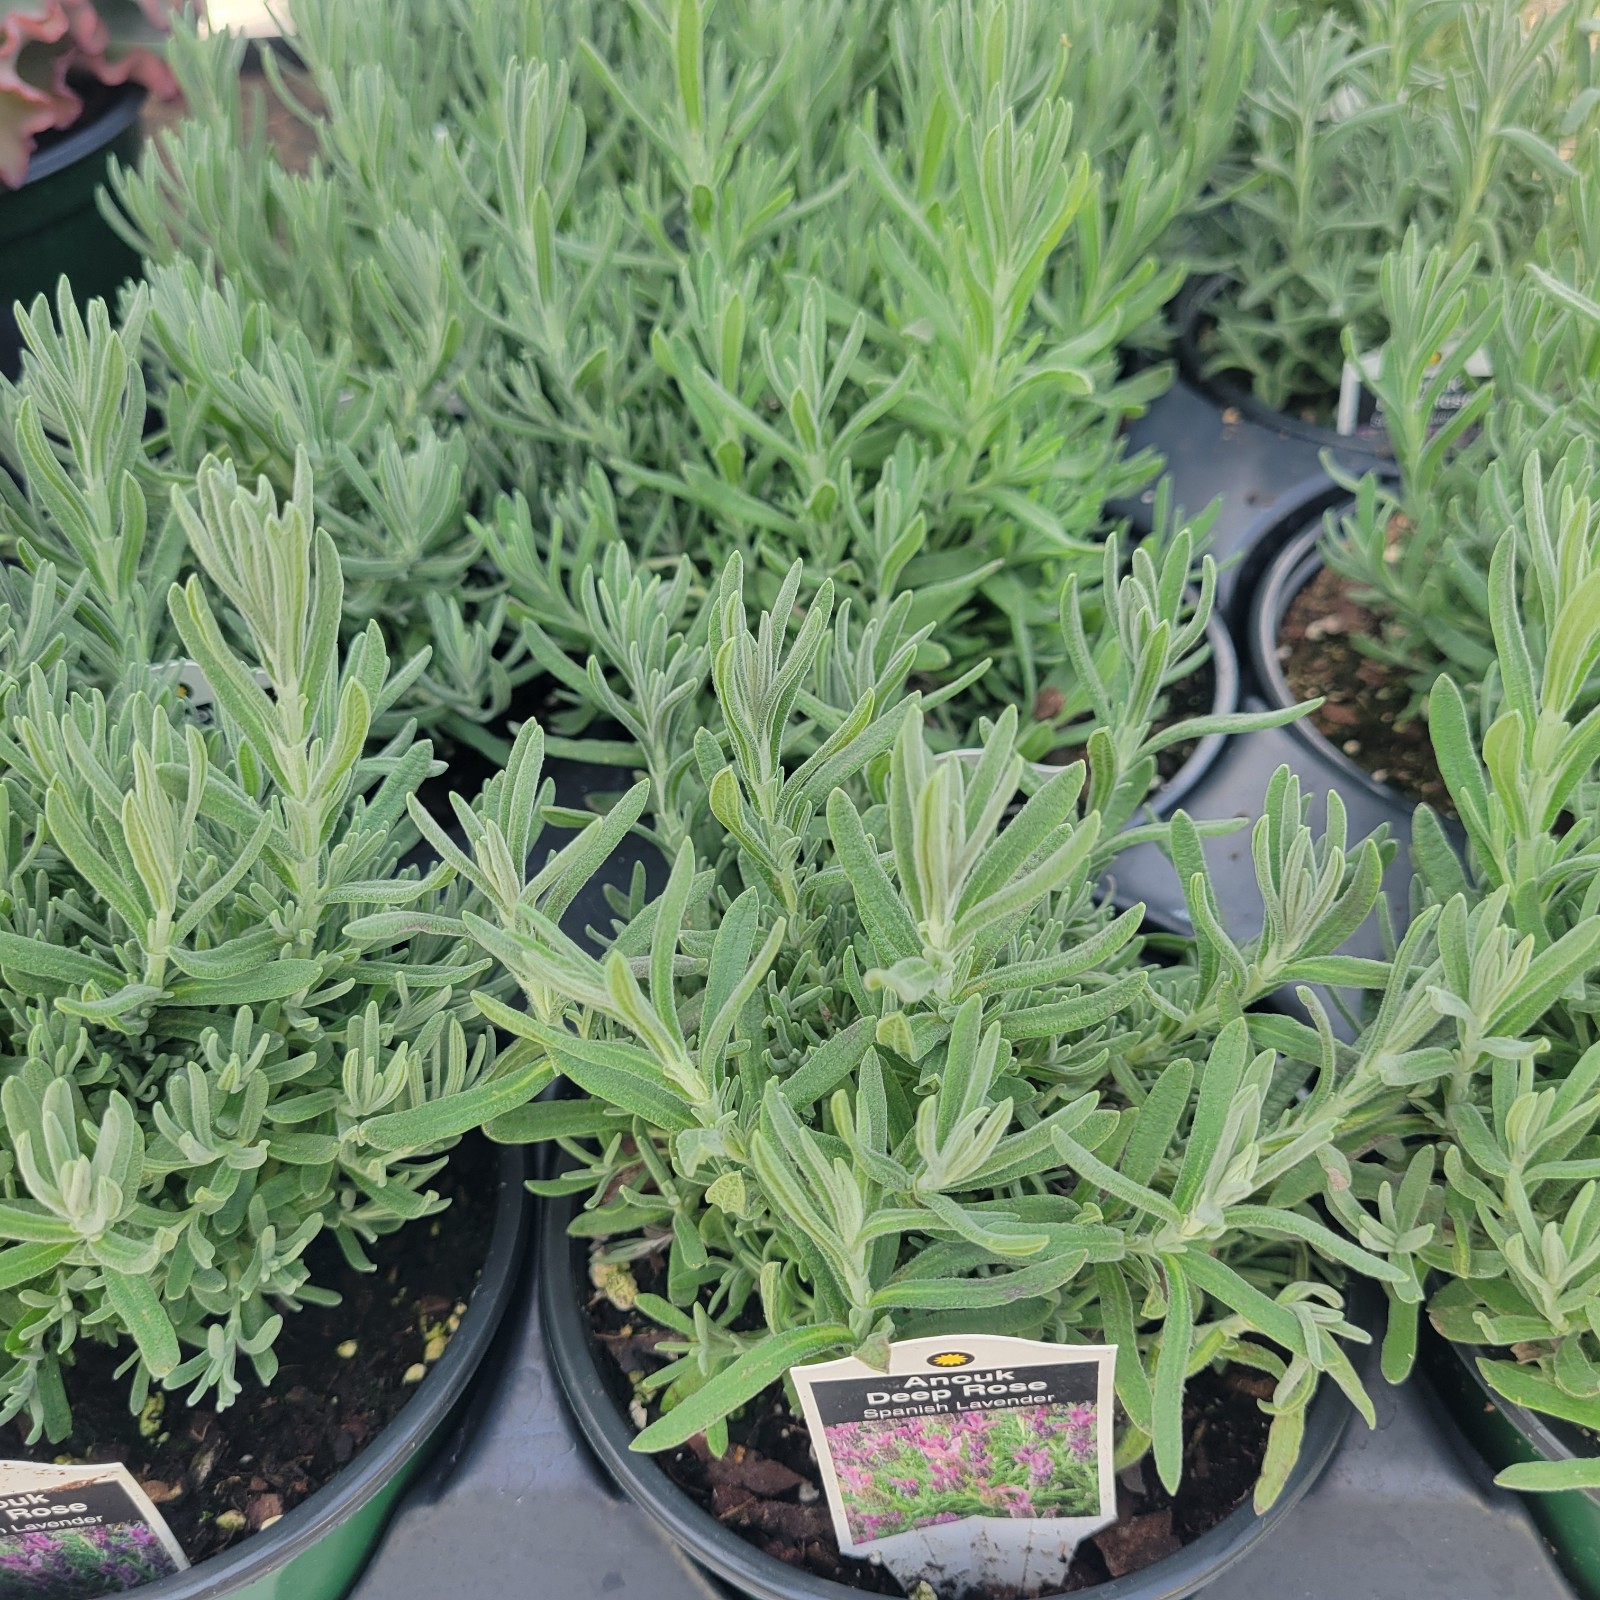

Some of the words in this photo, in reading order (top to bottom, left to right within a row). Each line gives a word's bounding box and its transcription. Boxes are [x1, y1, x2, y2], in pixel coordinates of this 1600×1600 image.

[903, 1369, 1015, 1389] Anouk
[866, 1388, 952, 1406] Deep
[962, 1381, 1048, 1397] Rose
[863, 1401, 949, 1420] Spanish
[956, 1394, 1056, 1411] Lavender
[5, 1502, 88, 1521] Rose
[10, 1515, 103, 1533] Lavender
